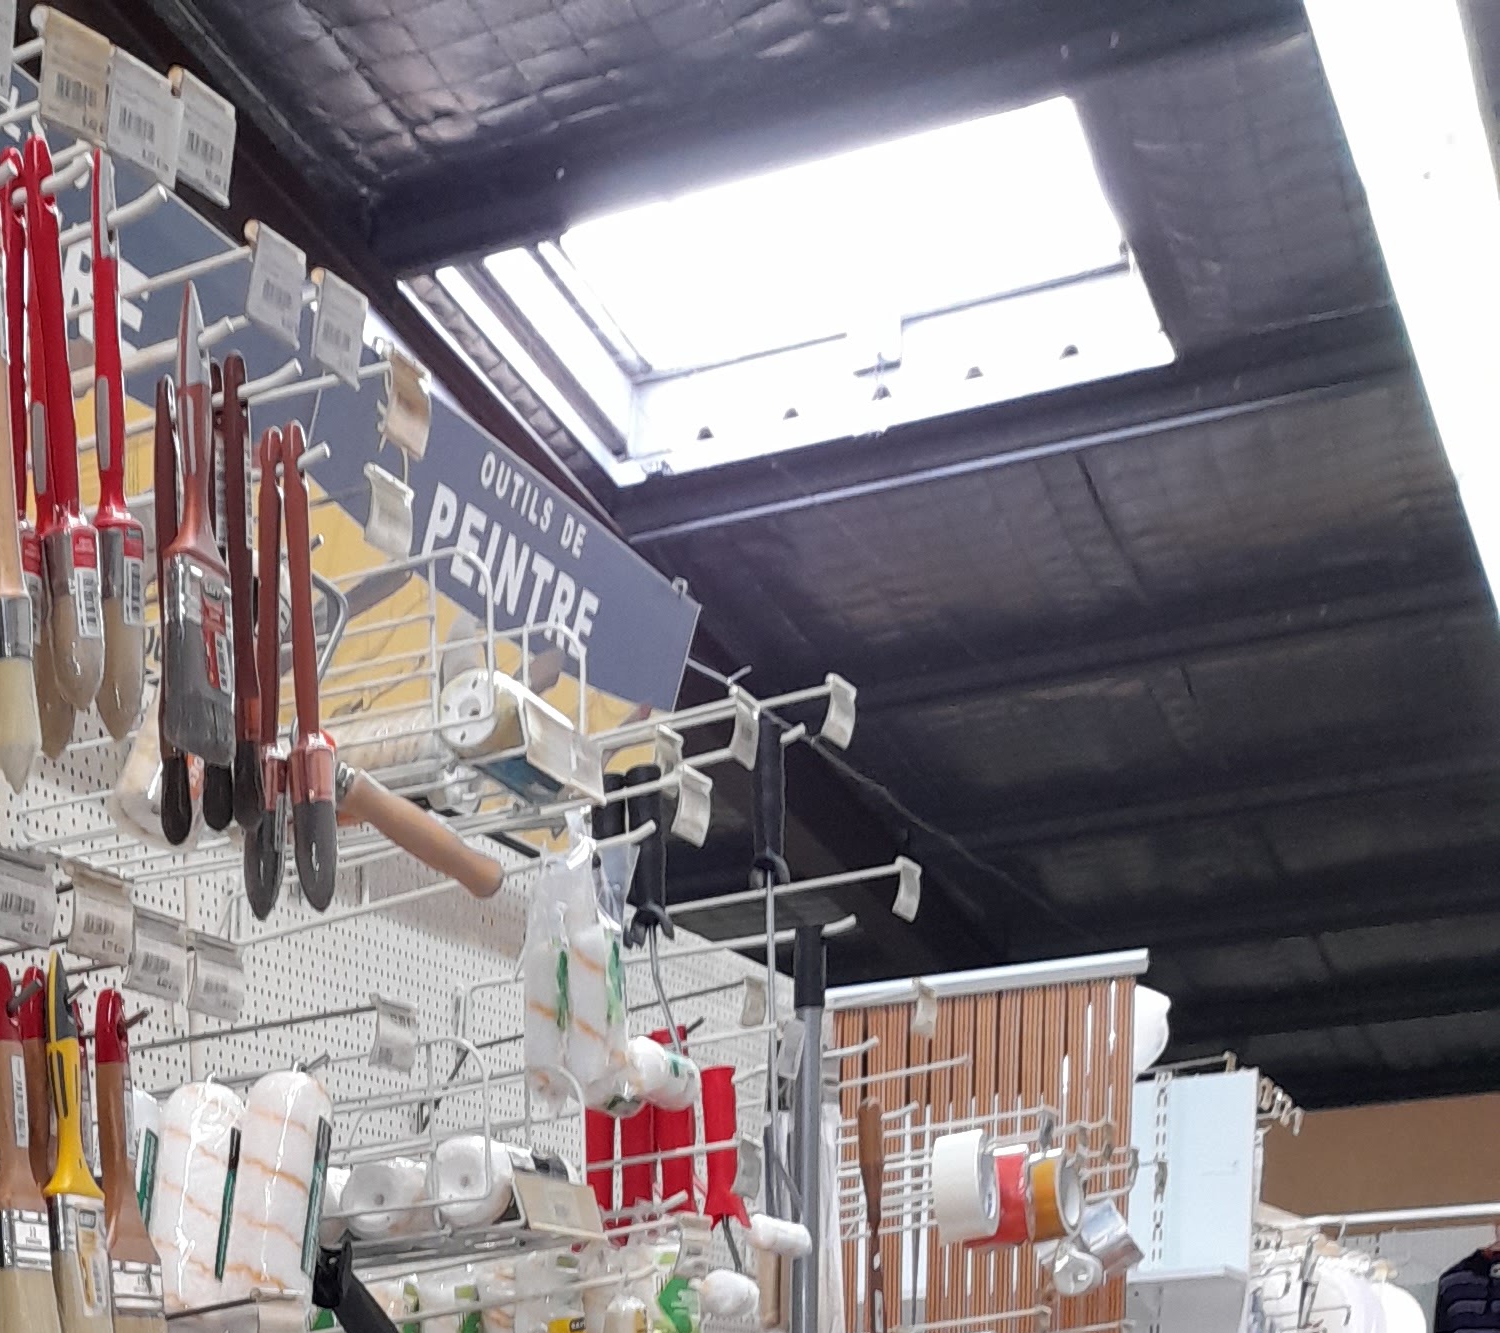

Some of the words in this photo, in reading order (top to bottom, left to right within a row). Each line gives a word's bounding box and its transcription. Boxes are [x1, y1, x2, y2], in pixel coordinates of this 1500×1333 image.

[420, 481, 600, 660] PEINTRE
[480, 450, 554, 534] OUTILS
[560, 512, 587, 560] DE
